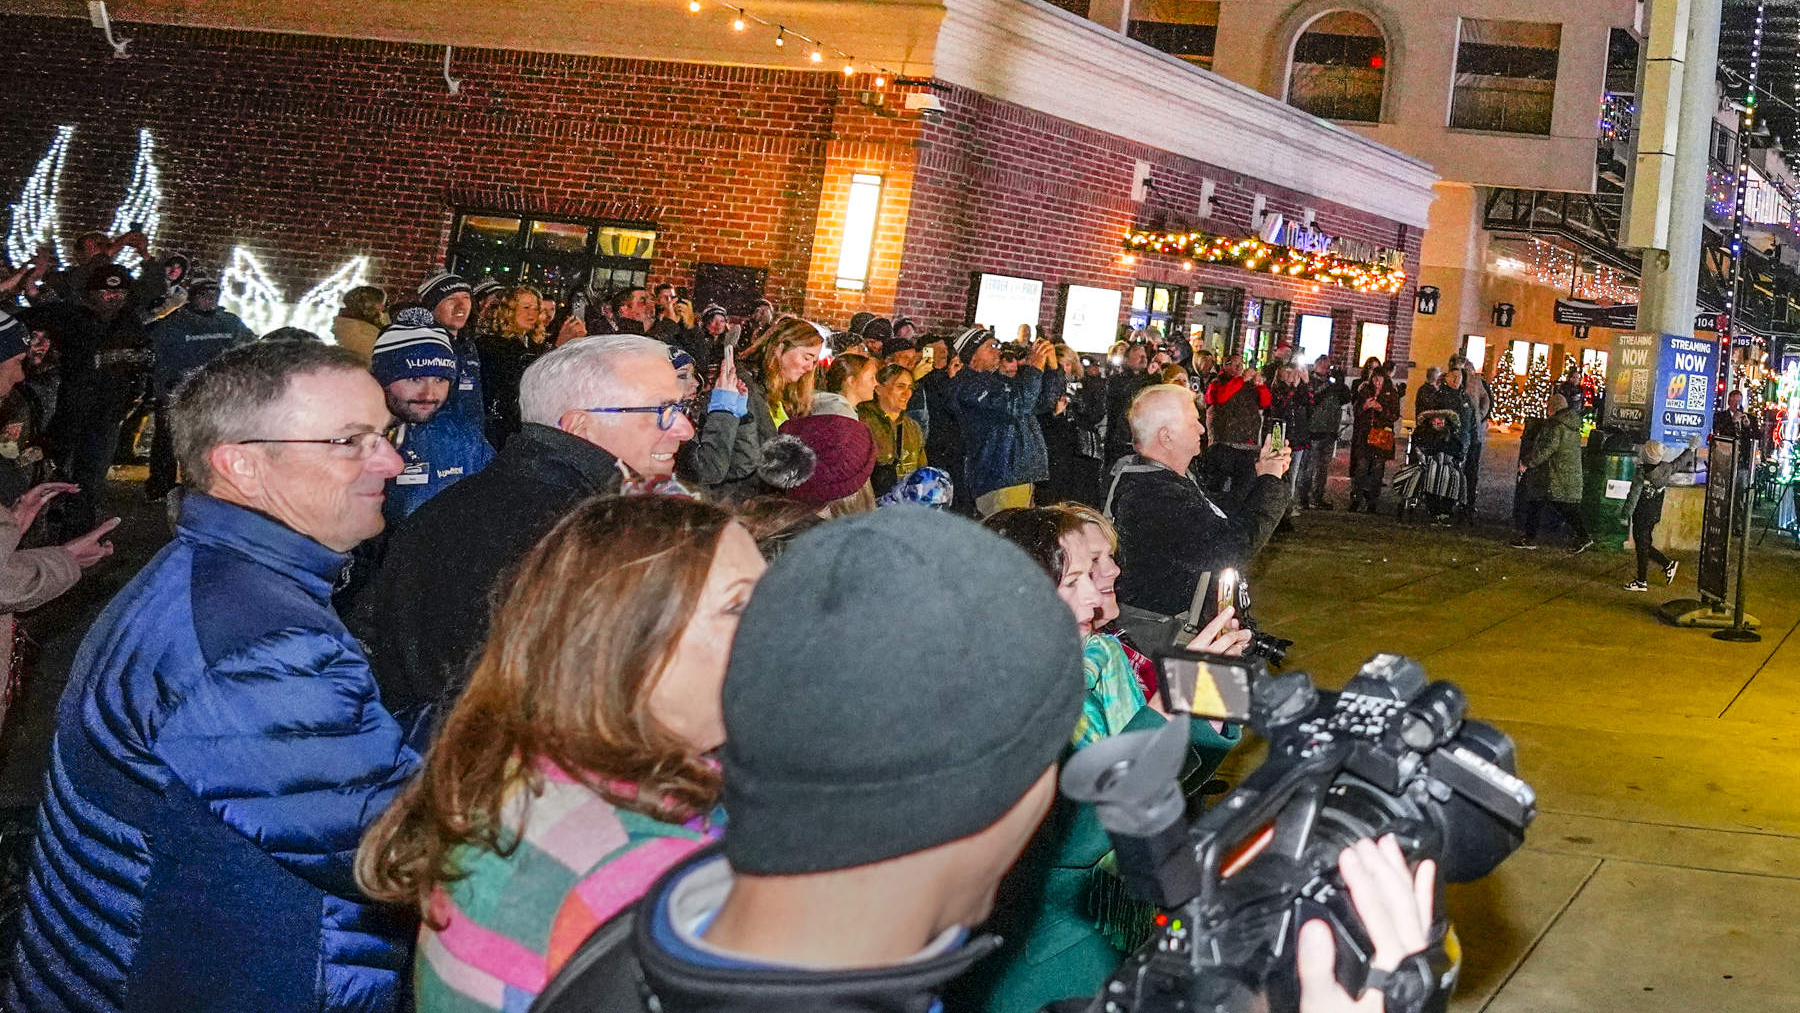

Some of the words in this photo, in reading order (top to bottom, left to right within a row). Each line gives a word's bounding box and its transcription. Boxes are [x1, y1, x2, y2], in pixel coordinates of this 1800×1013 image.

[1697, 318, 1714, 328] 104
[1620, 336, 1653, 346] STREAMING
[1671, 339, 1711, 354] STREAMING
[1621, 349, 1648, 366] NOW
[1675, 353, 1707, 373] NOW
[1675, 413, 1702, 426] WFMZ+
